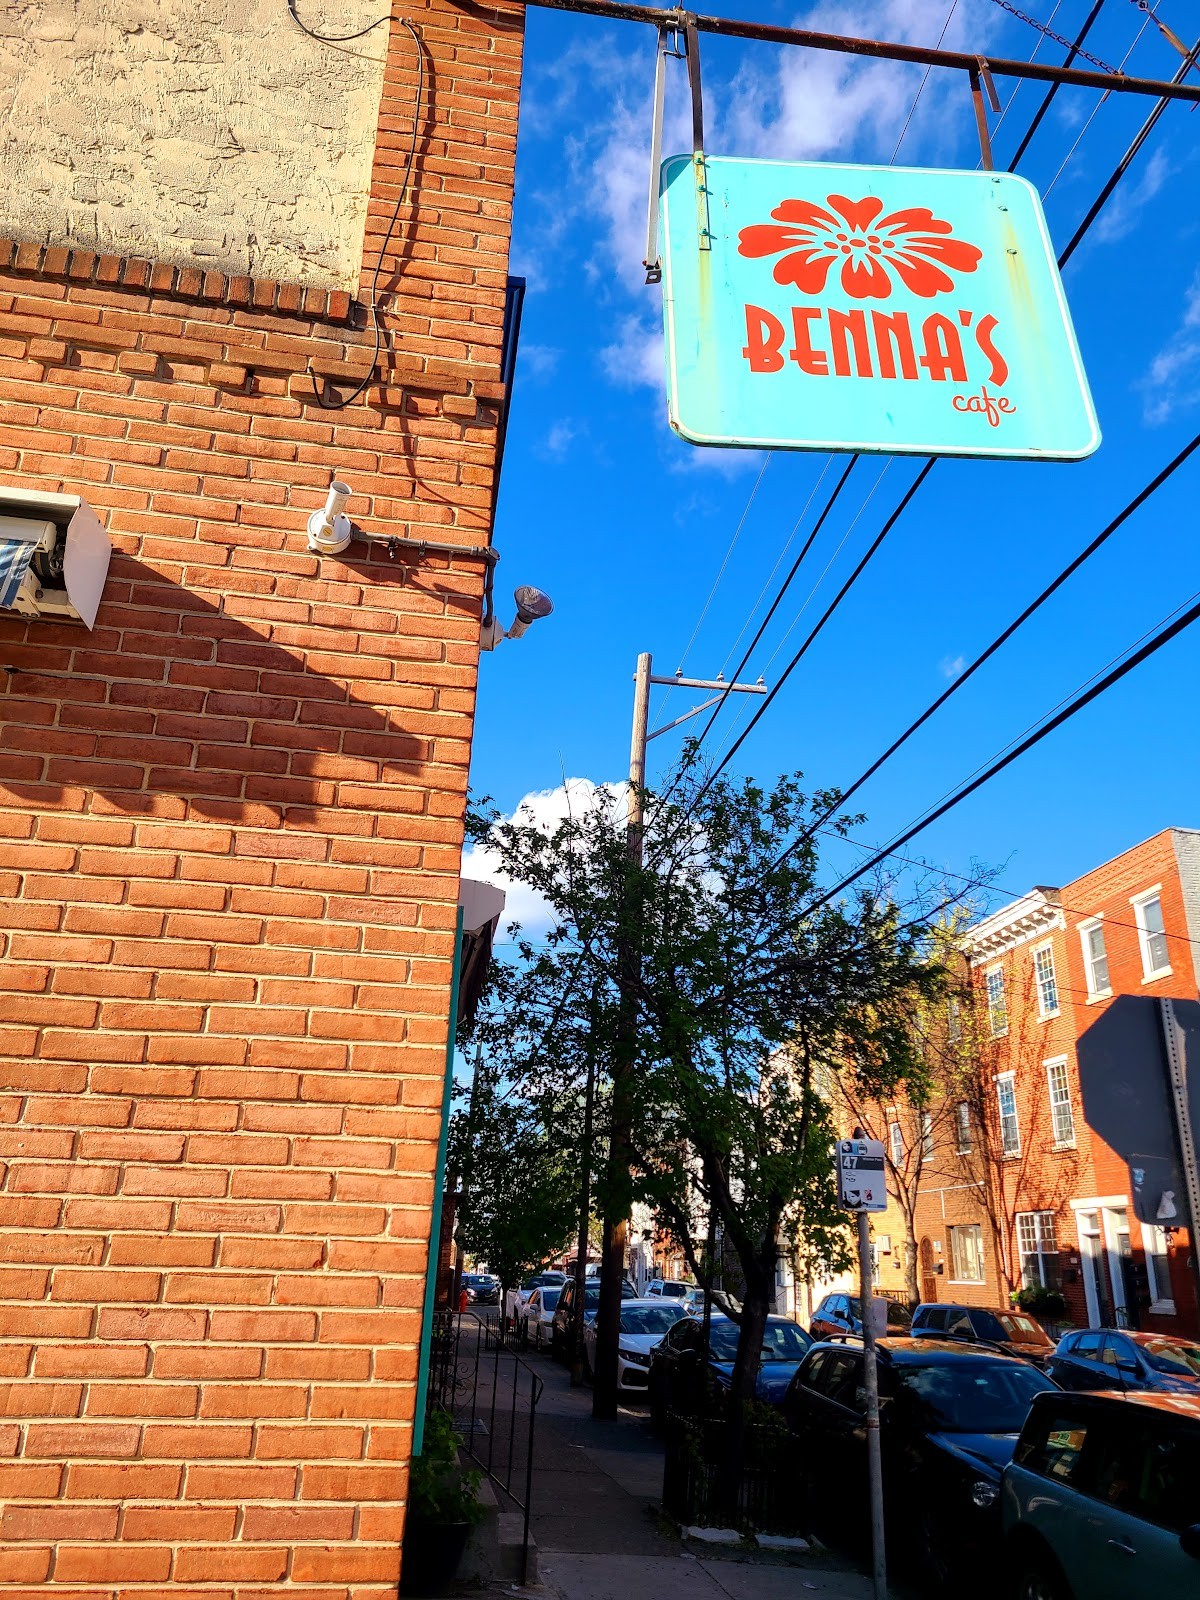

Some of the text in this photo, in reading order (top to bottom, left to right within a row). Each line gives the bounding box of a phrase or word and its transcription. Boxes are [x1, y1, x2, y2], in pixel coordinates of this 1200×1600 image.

[742, 303, 1010, 387] BENNA'S
[952, 386, 1017, 428] cafe
[843, 1156, 858, 1169] 47
